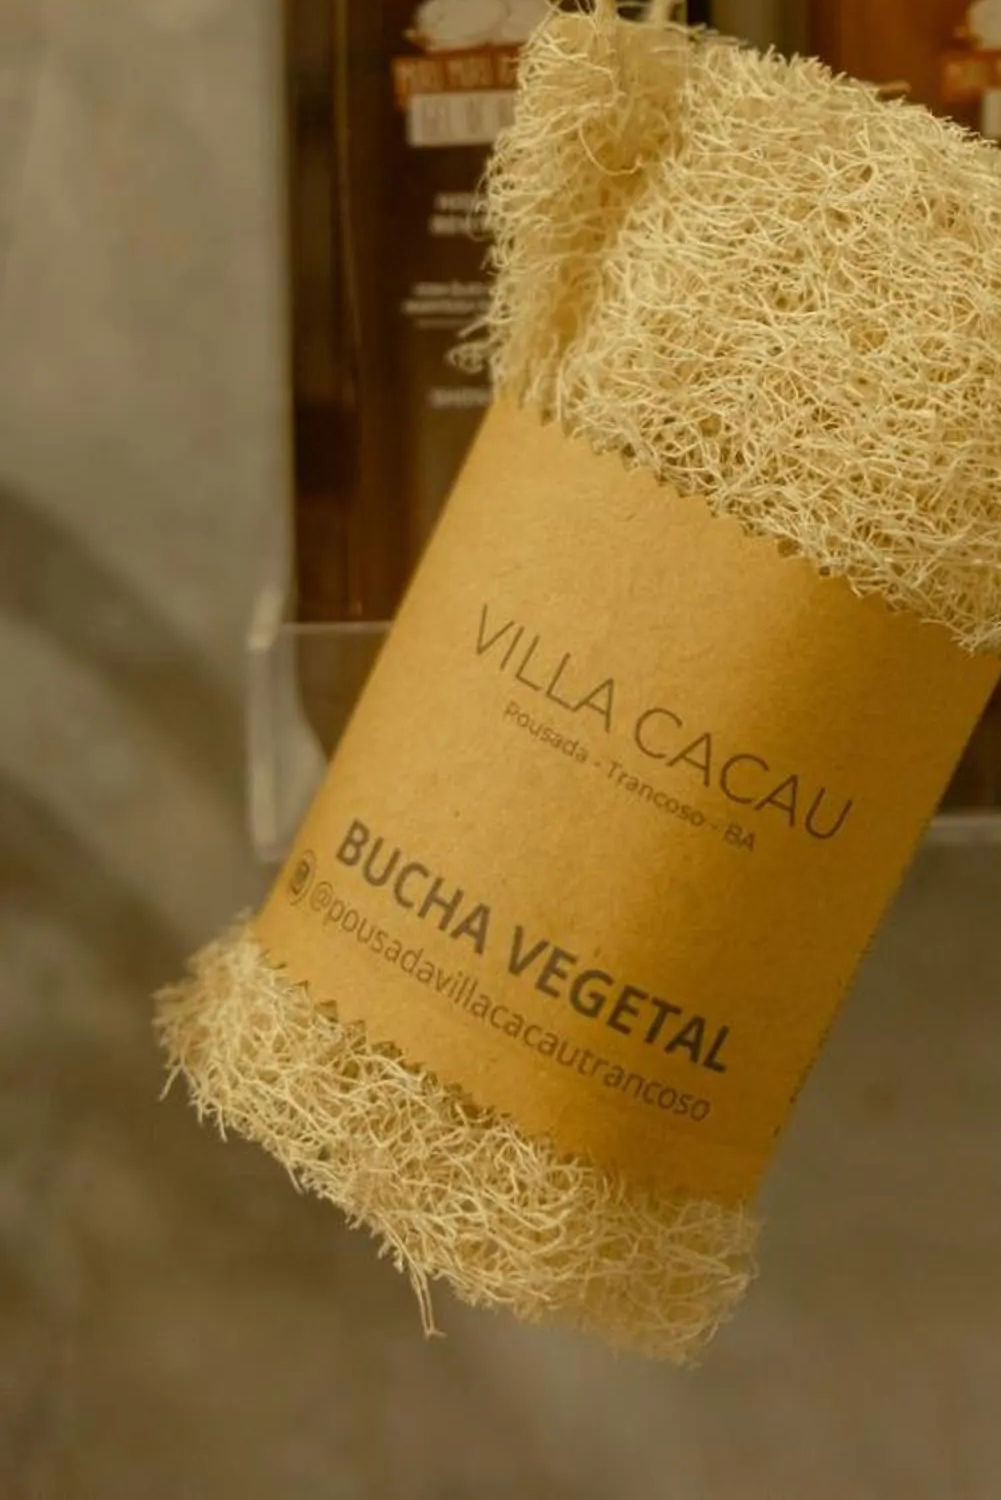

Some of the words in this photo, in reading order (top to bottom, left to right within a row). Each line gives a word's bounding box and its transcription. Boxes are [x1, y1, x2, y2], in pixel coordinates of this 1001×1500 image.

[475, 603, 615, 734] VILLA
[633, 706, 854, 841] CACAU
[504, 701, 588, 764] Pousada
[607, 760, 705, 827] Trancoso
[723, 822, 756, 852] BA
[310, 881, 712, 1123] @pousadavillacacautrancoso
[336, 818, 491, 956] BUCHA
[509, 925, 732, 1074] VEGETAL
